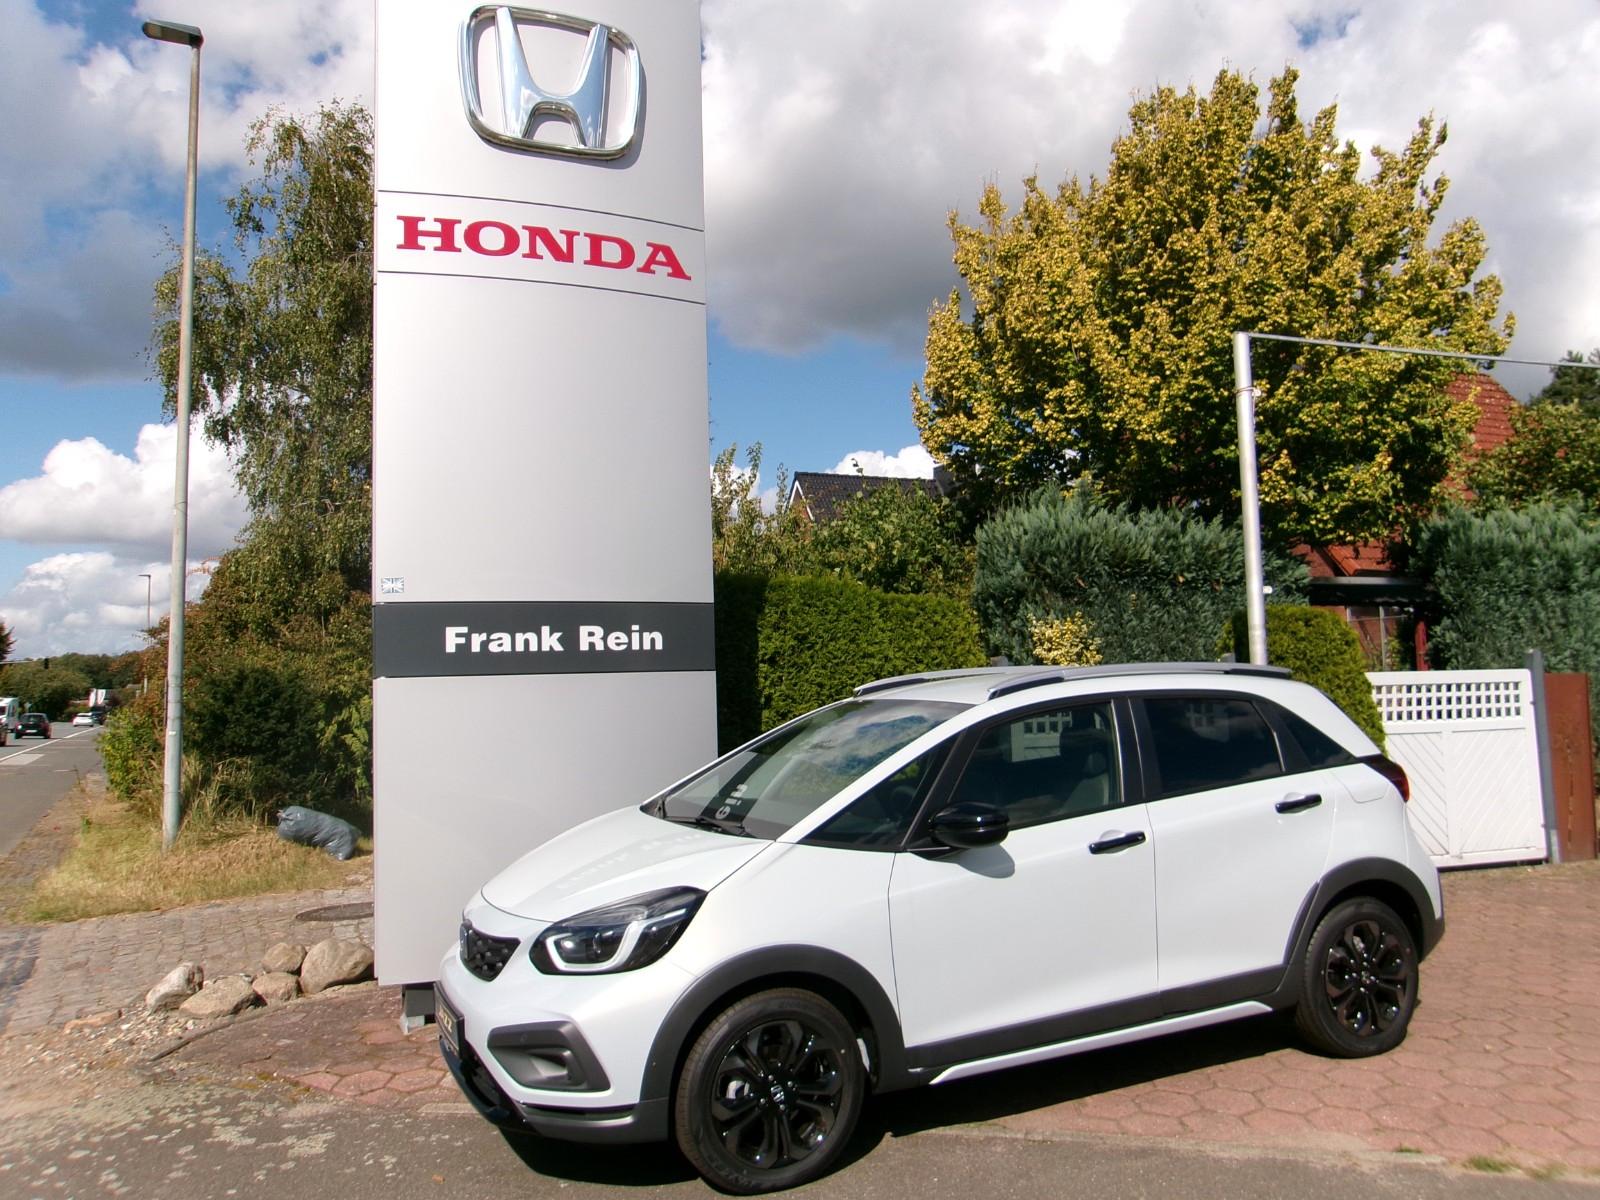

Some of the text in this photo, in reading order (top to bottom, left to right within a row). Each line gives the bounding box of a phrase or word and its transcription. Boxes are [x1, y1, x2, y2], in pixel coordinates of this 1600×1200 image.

[396, 215, 691, 280] HONDA
[445, 625, 663, 653] Frank Rein
